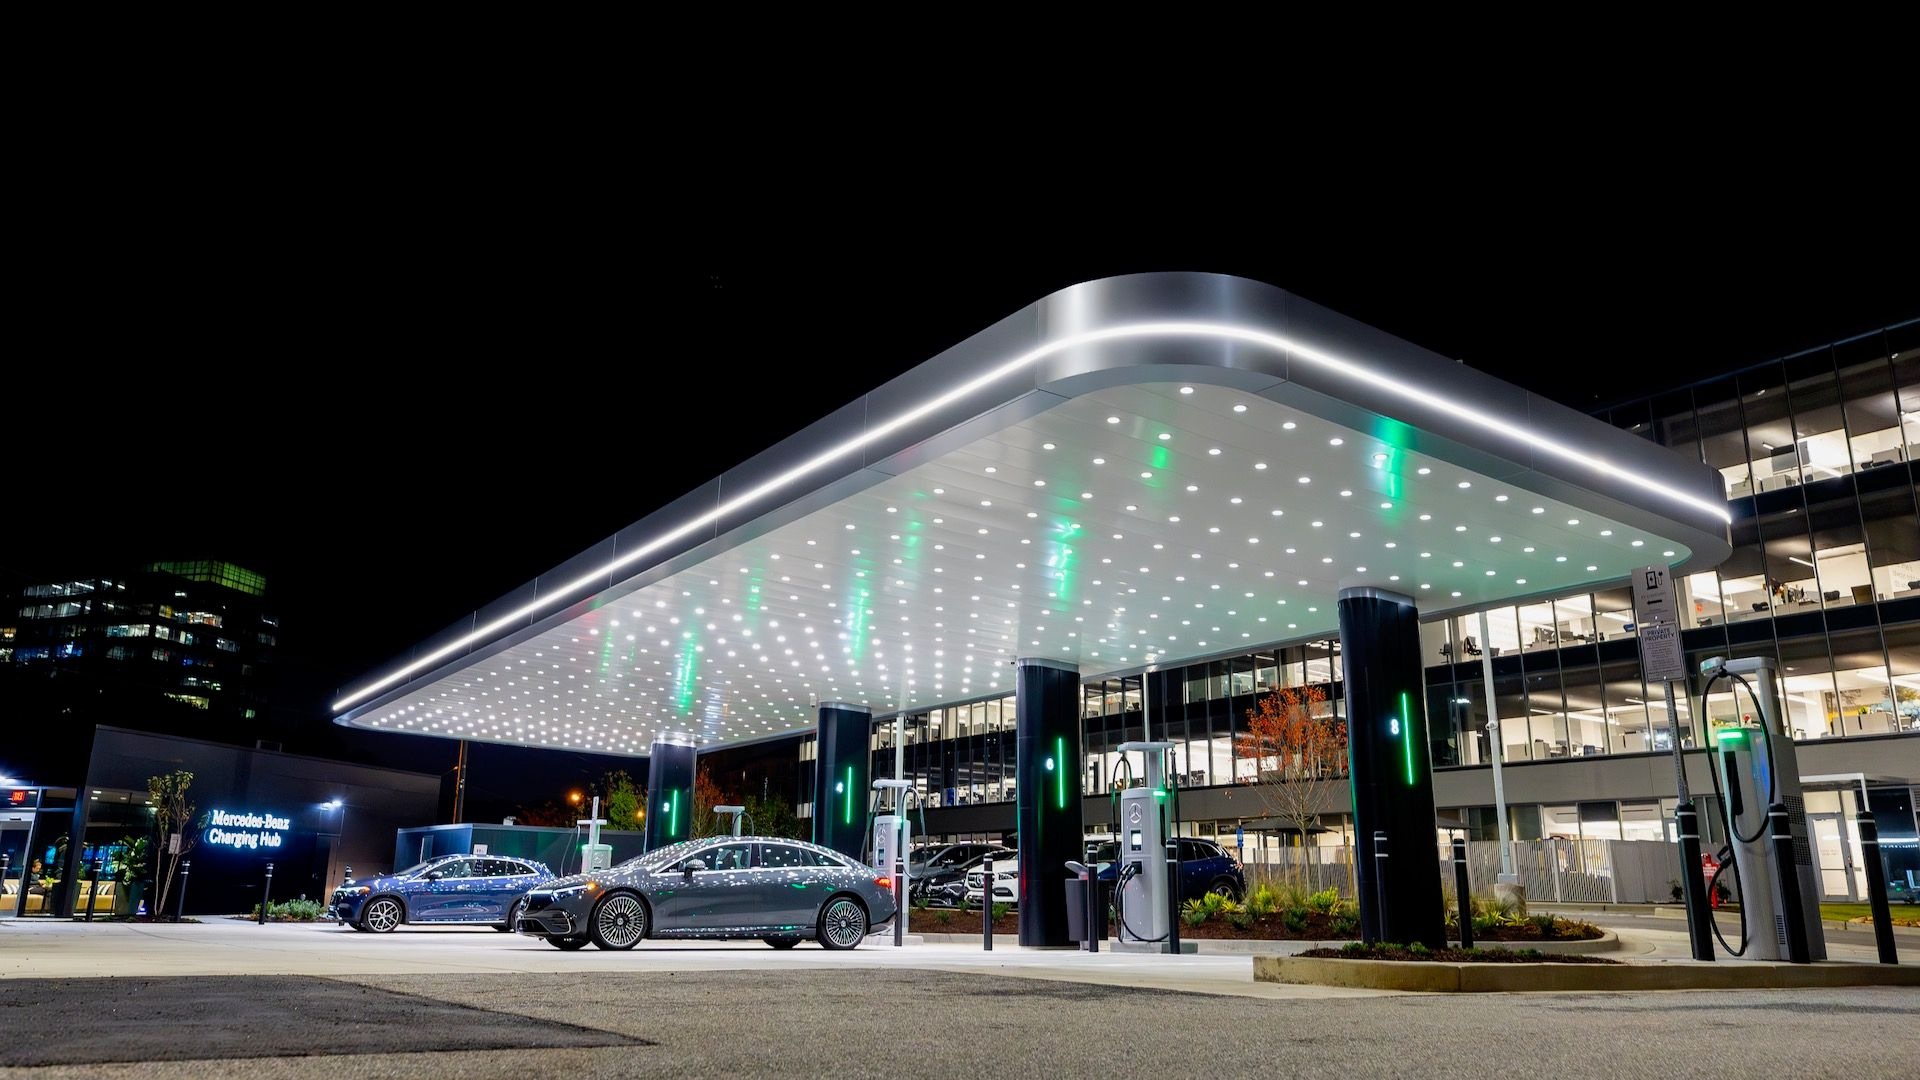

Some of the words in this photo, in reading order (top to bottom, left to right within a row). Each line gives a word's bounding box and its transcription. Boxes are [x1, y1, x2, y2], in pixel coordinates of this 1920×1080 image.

[1645, 632, 1675, 641] PROPERTY
[1647, 628, 1670, 636] PRIVATE
[1390, 719, 1399, 735] 8
[211, 809, 290, 830] Mercedes-Benz
[209, 828, 259, 849] Charging
[260, 831, 281, 847] Hub
